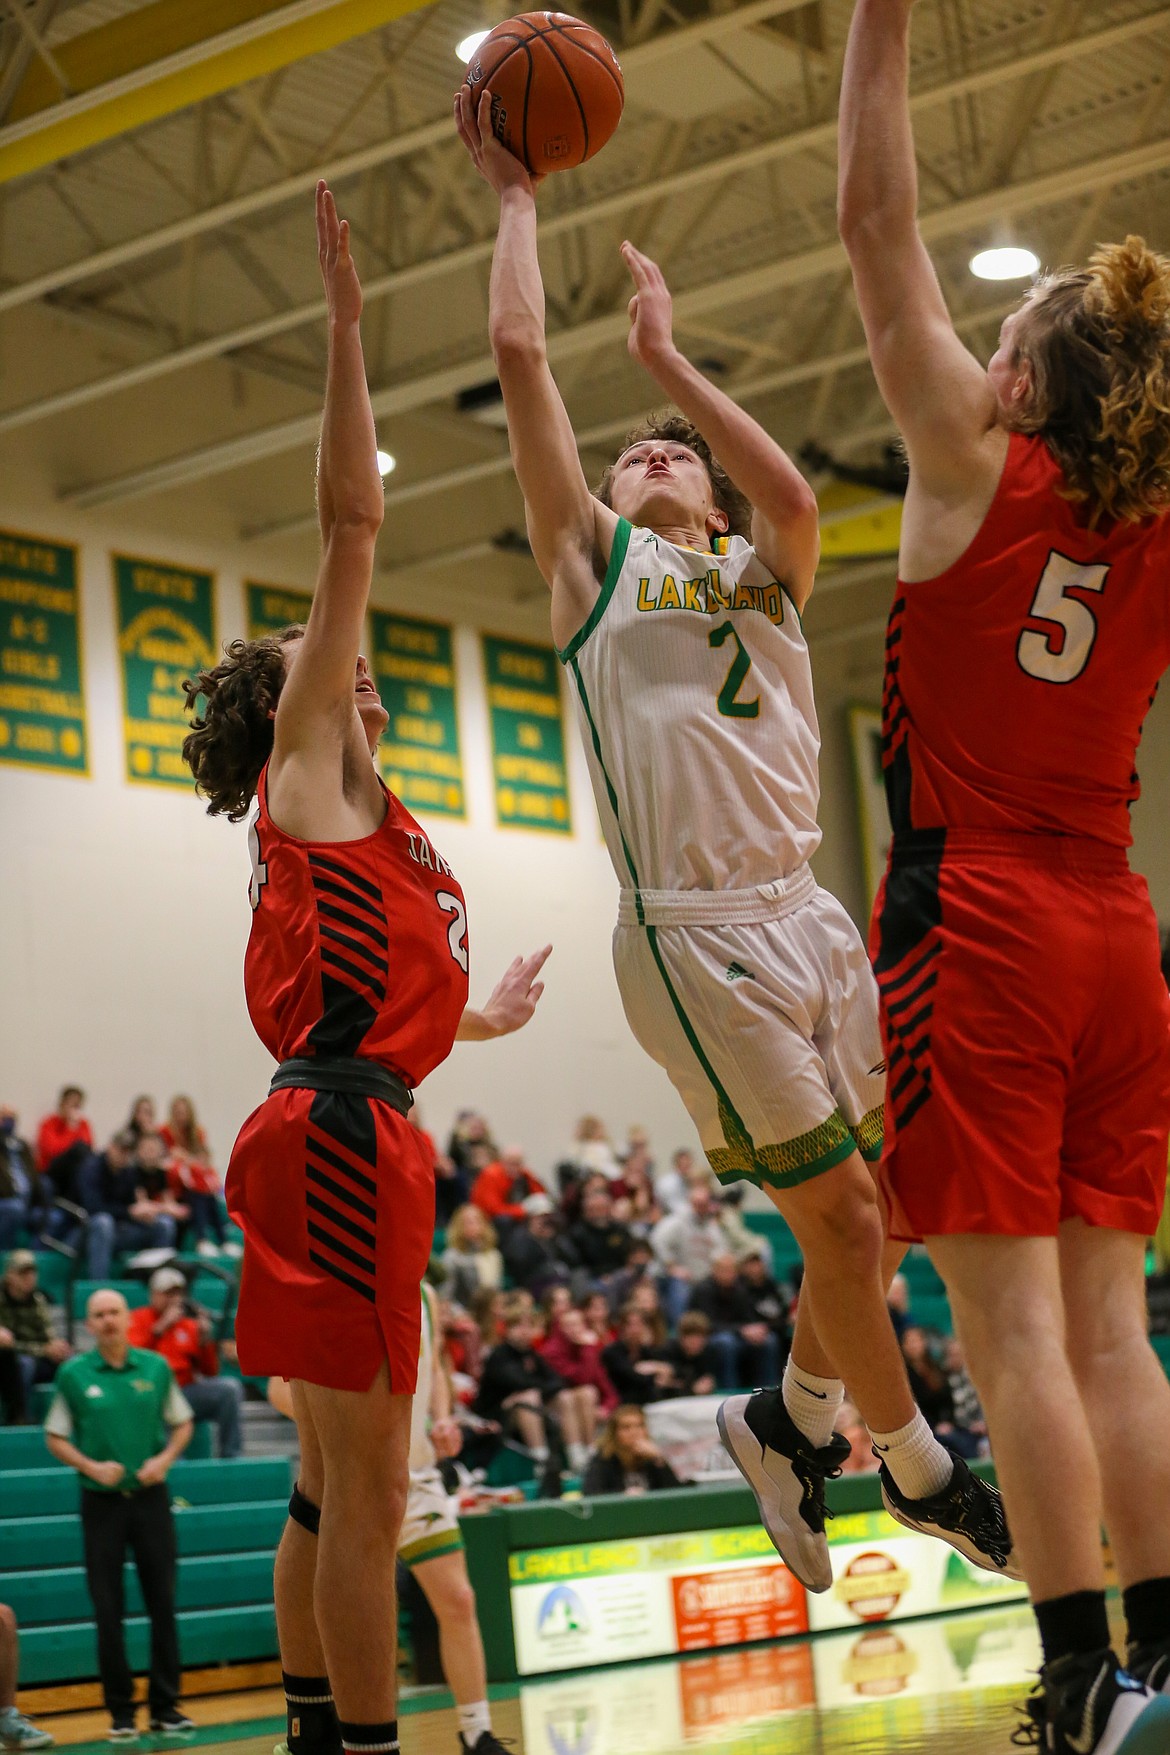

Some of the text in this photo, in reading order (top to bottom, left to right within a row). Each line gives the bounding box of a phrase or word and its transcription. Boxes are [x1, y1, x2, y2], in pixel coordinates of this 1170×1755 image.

[1015, 547, 1112, 685] 5
[708, 619, 761, 721] 2
[435, 888, 469, 976] 2
